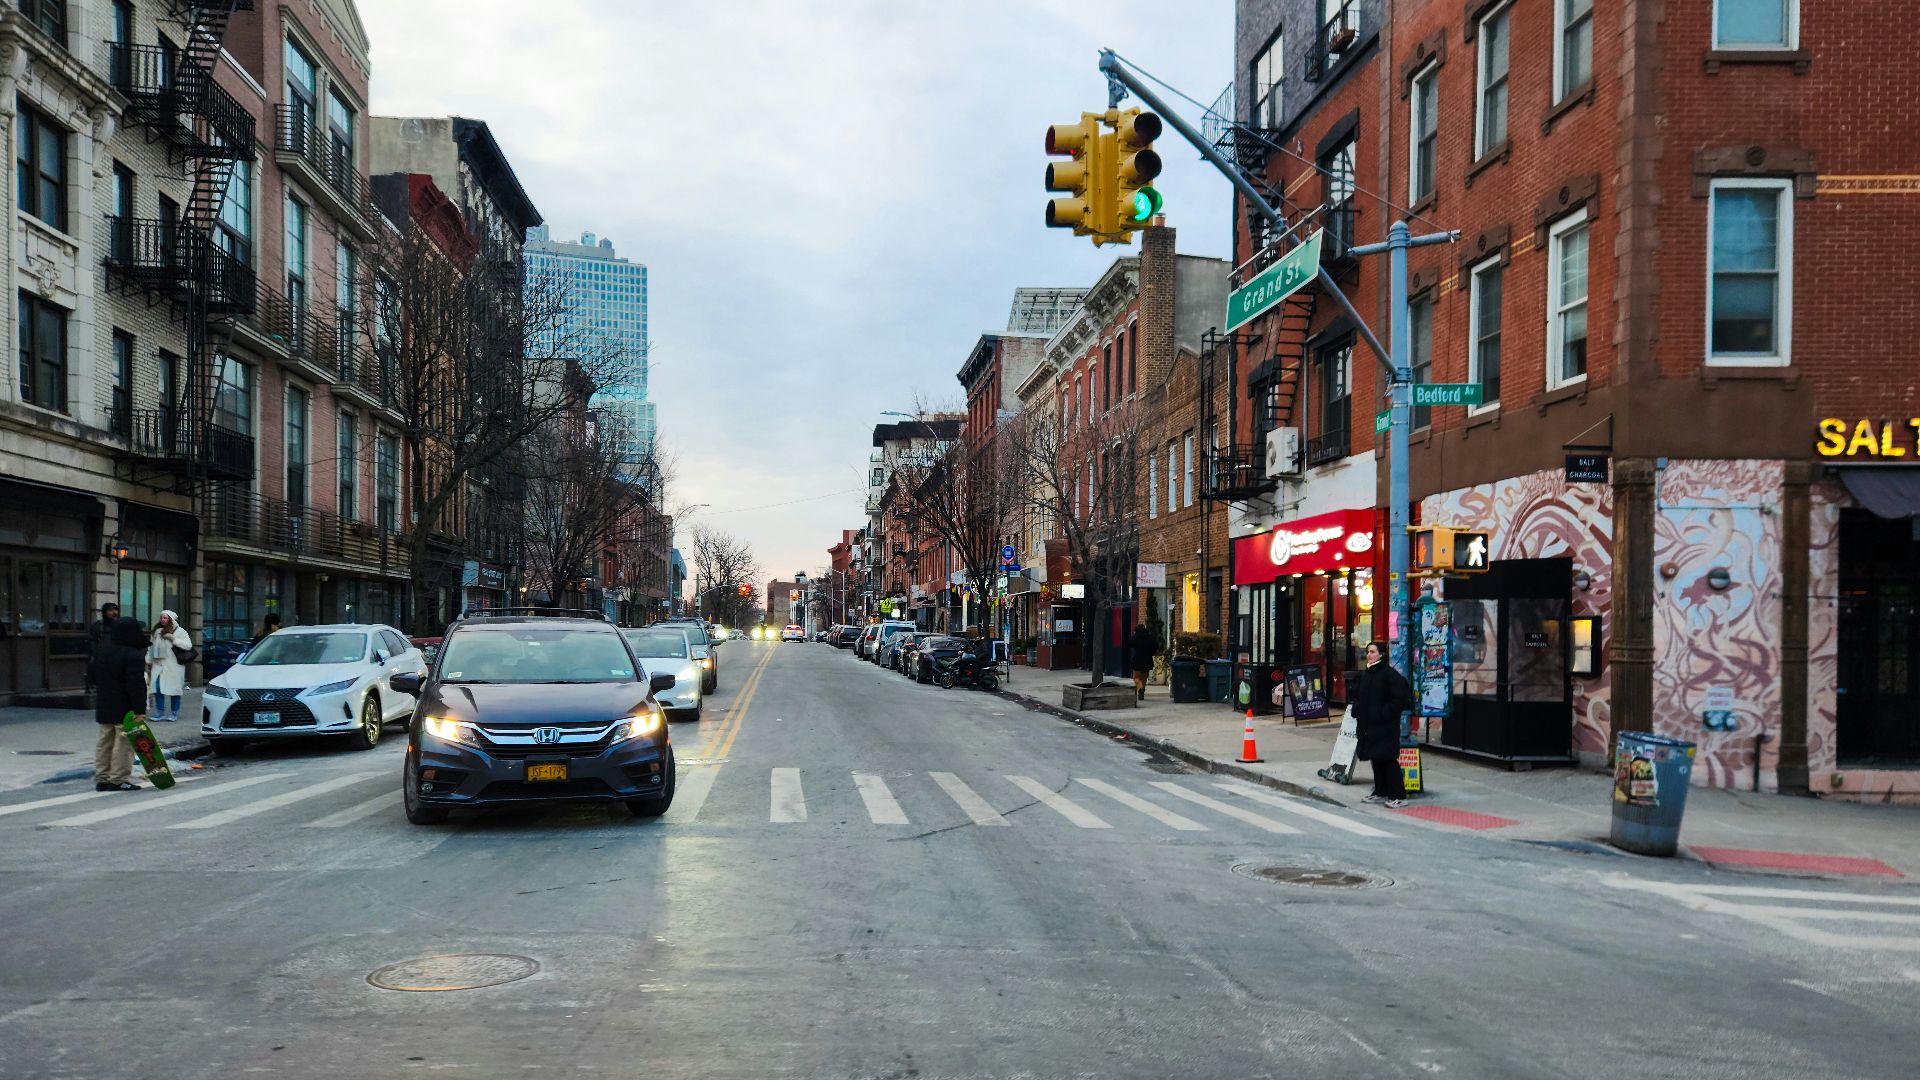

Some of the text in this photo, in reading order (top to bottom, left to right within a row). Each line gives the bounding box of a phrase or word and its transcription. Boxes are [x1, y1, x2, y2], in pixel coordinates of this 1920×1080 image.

[1243, 258, 1300, 312] Grand St
[1417, 386, 1475, 403] Bedford Av
[1376, 411, 1390, 430] Grand
[1579, 458, 1595, 466] SALT
[1569, 471, 1604, 479] CHARCOAL
